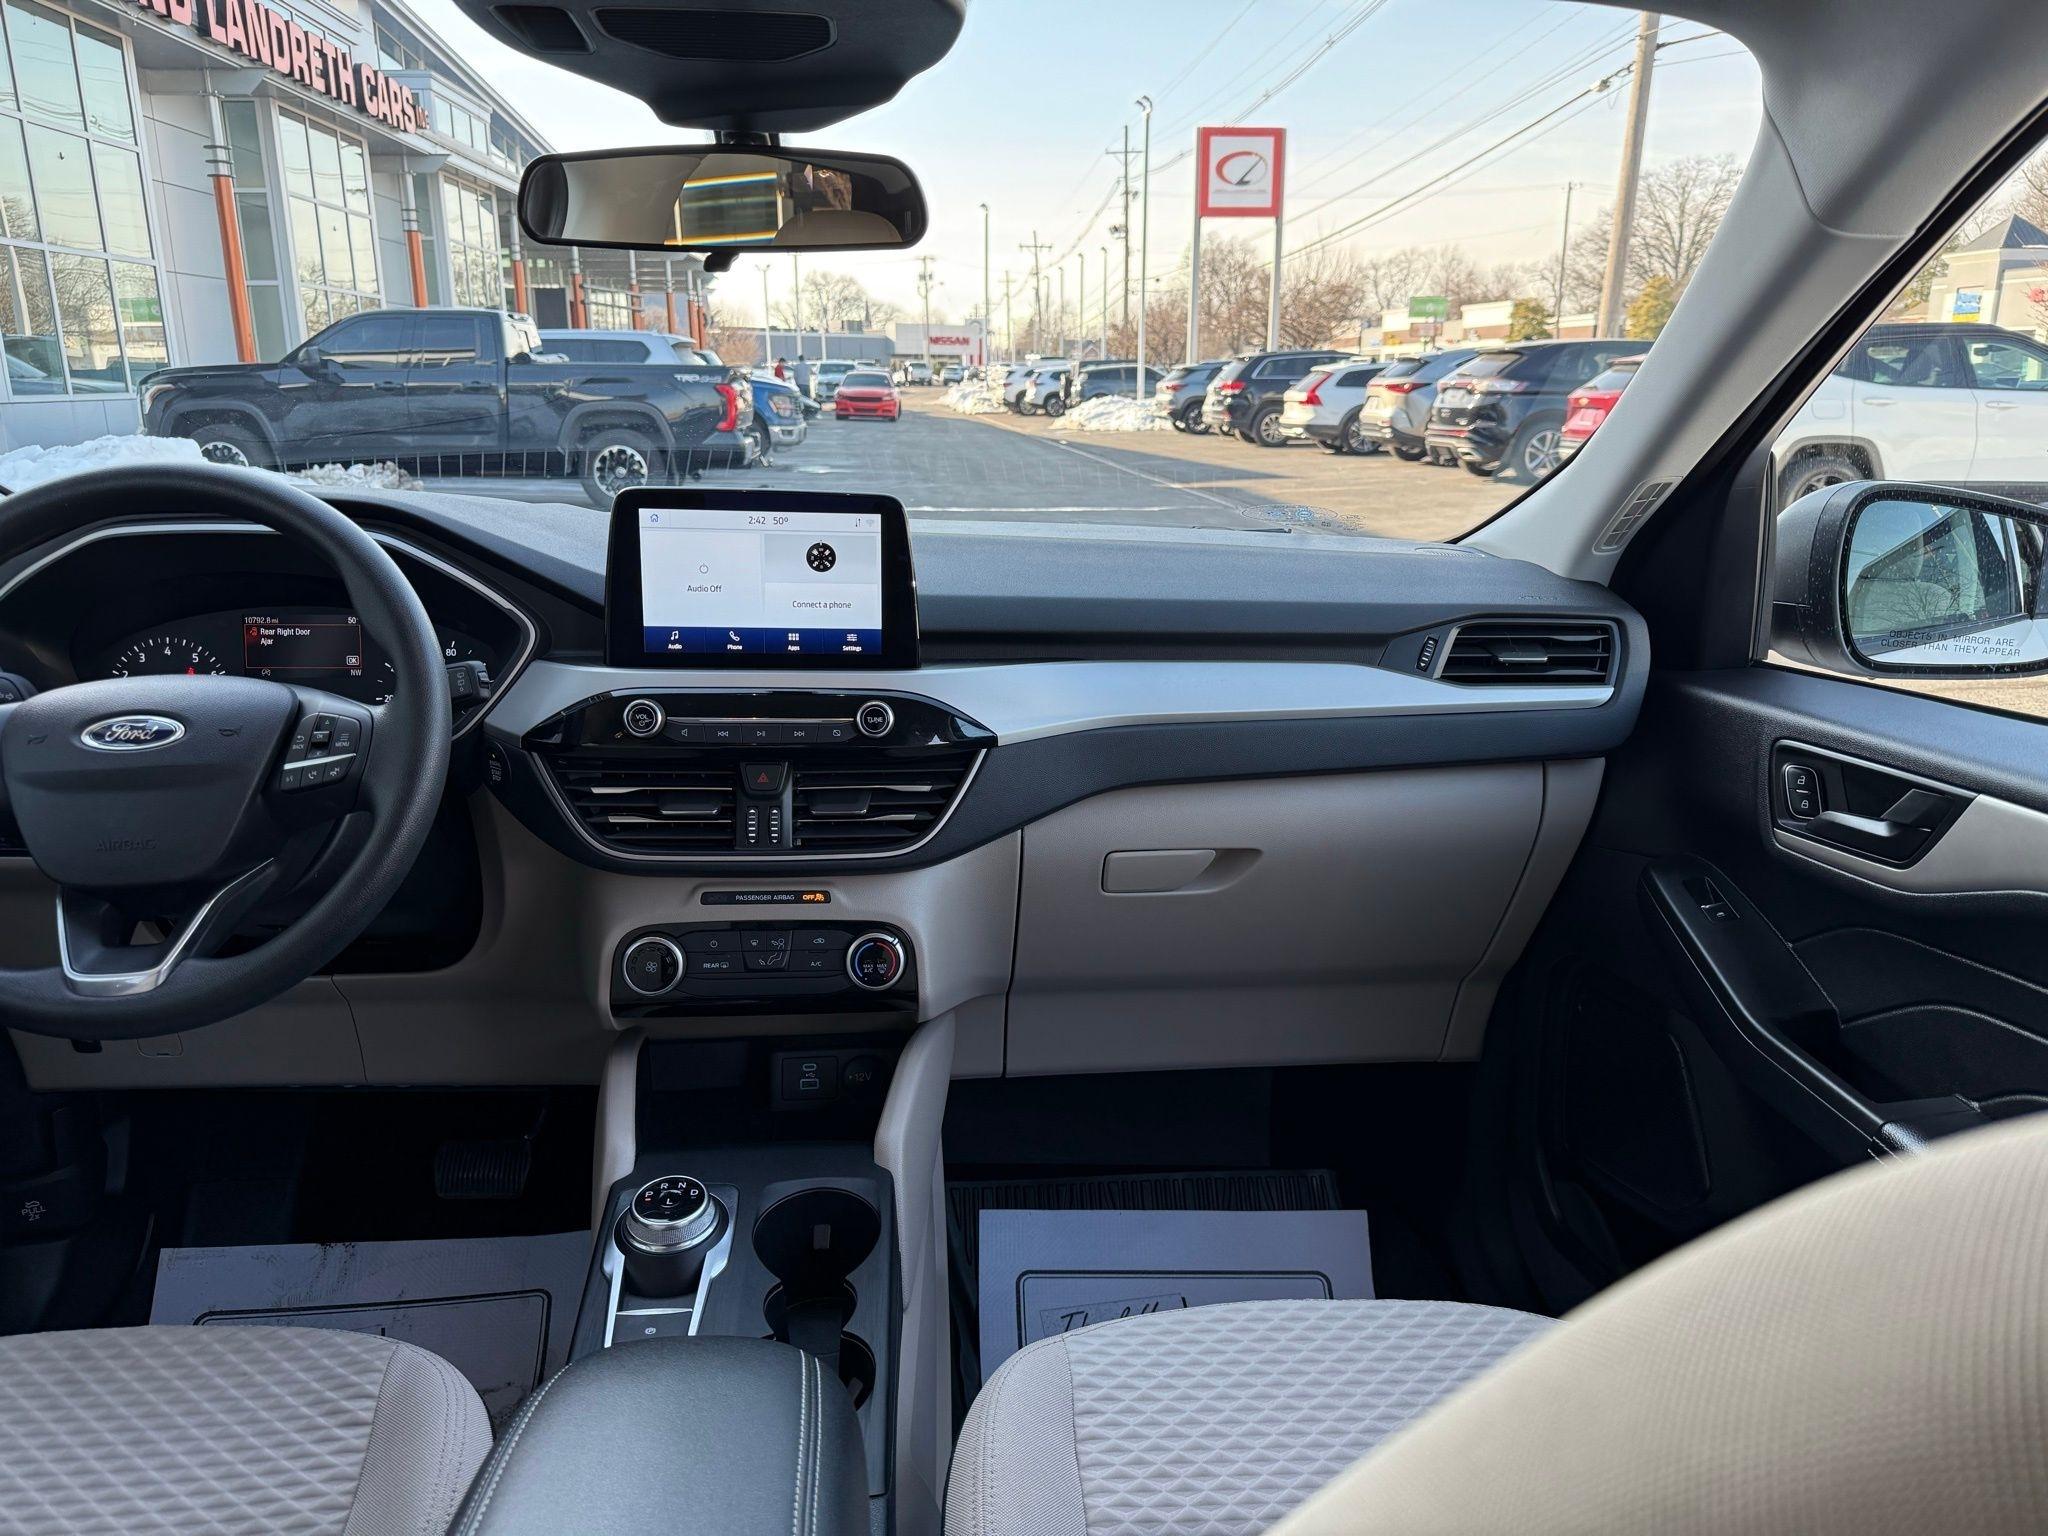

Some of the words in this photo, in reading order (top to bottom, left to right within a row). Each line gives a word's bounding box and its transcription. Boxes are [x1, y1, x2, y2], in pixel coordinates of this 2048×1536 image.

[206, 0, 357, 107] LANDRETH
[360, 63, 417, 134] CARS
[929, 336, 970, 346] NISSAN
[748, 516, 766, 525] 2:42
[687, 584, 709, 593] Audio
[710, 584, 722, 593] Off
[792, 600, 822, 609] Connect
[828, 600, 852, 610] phone
[260, 628, 275, 636] Rear
[277, 628, 294, 637] Right
[295, 628, 311, 636] Door
[260, 638, 274, 646] Ajar
[1889, 630, 1932, 641] OBJECTS
[1937, 633, 1947, 642] IN
[1953, 635, 1990, 645] MIRROR
[1995, 638, 2014, 647] ARE
[164, 646, 171, 656] 4
[727, 643, 743, 651] Phone
[1881, 638, 1918, 648] CLOSER
[1923, 642, 1948, 652] THAN
[1954, 644, 1979, 654] THEY
[1982, 646, 2021, 657] APPEAR
[139, 653, 146, 663] 3
[192, 653, 199, 663] 5
[445, 649, 457, 657] 80
[104, 720, 159, 742] Ford
[96, 838, 158, 852] AIRBAG
[802, 893, 815, 901] OFF
